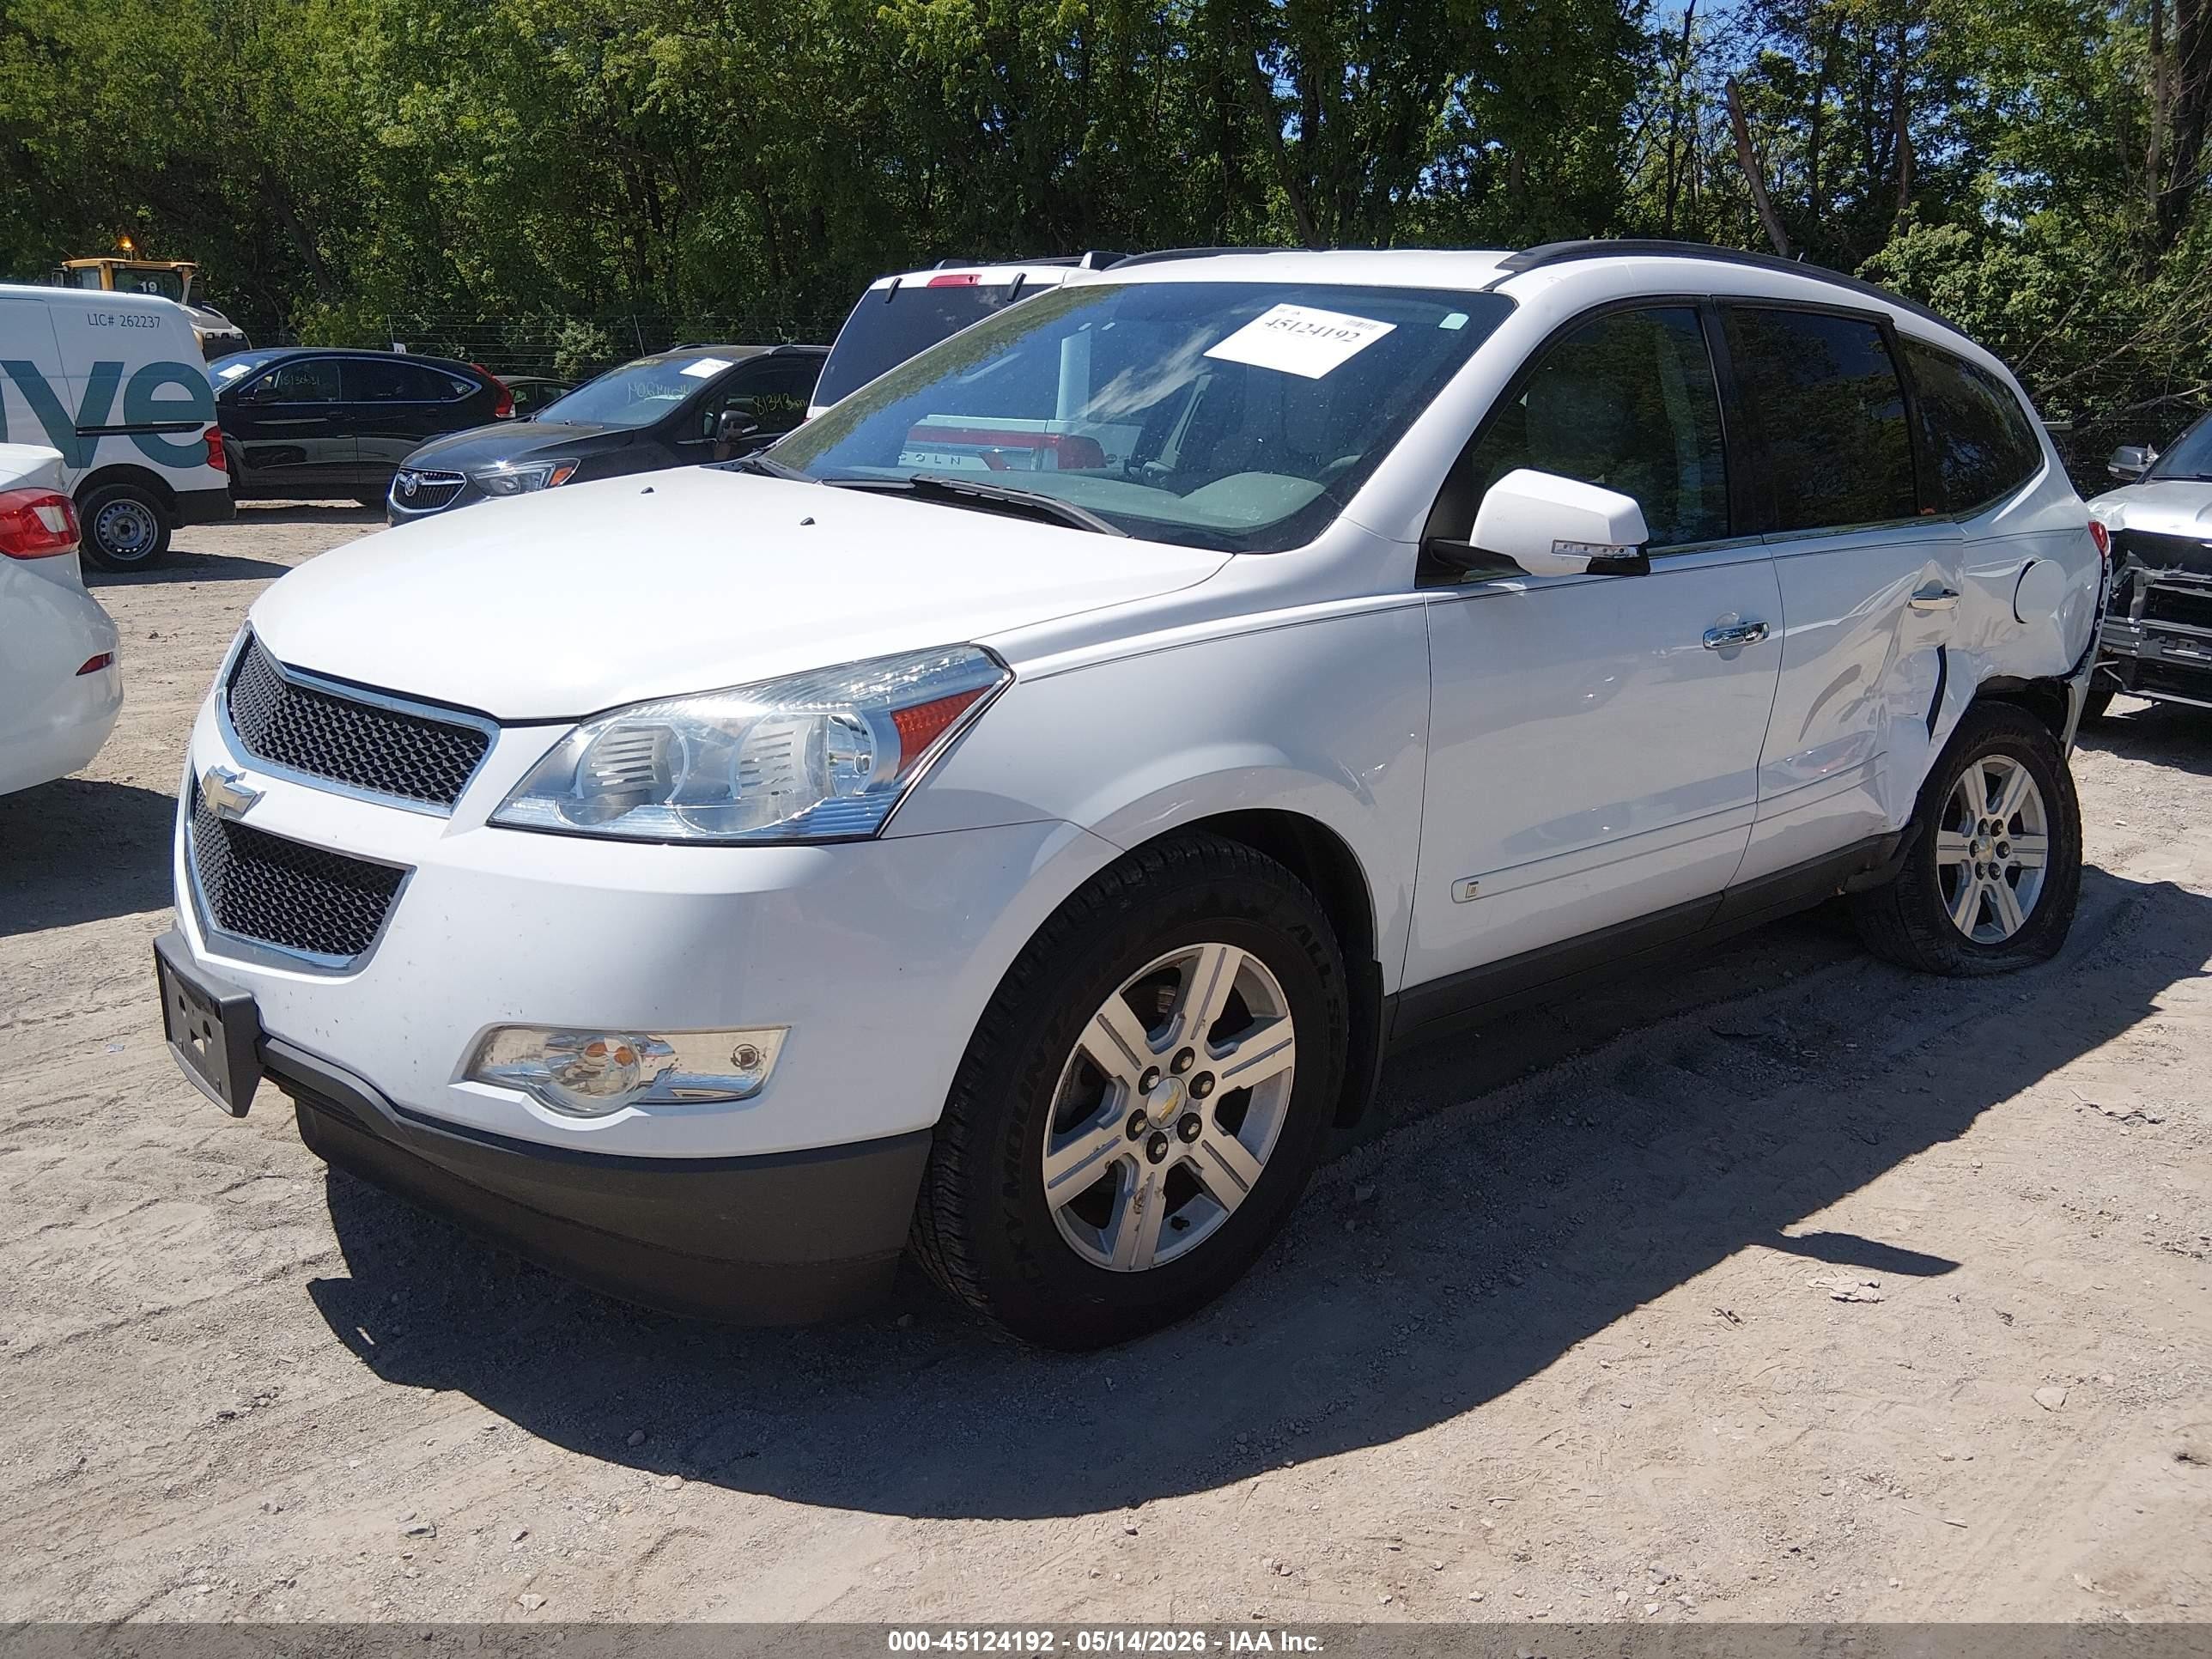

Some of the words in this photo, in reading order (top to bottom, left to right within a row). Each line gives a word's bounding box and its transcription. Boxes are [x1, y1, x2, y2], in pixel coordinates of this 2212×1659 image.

[140, 281, 158, 293] 19
[88, 313, 115, 327] LIC#
[120, 315, 161, 328] 262237
[1264, 317, 1361, 343] 45124192
[0, 360, 217, 468] ve
